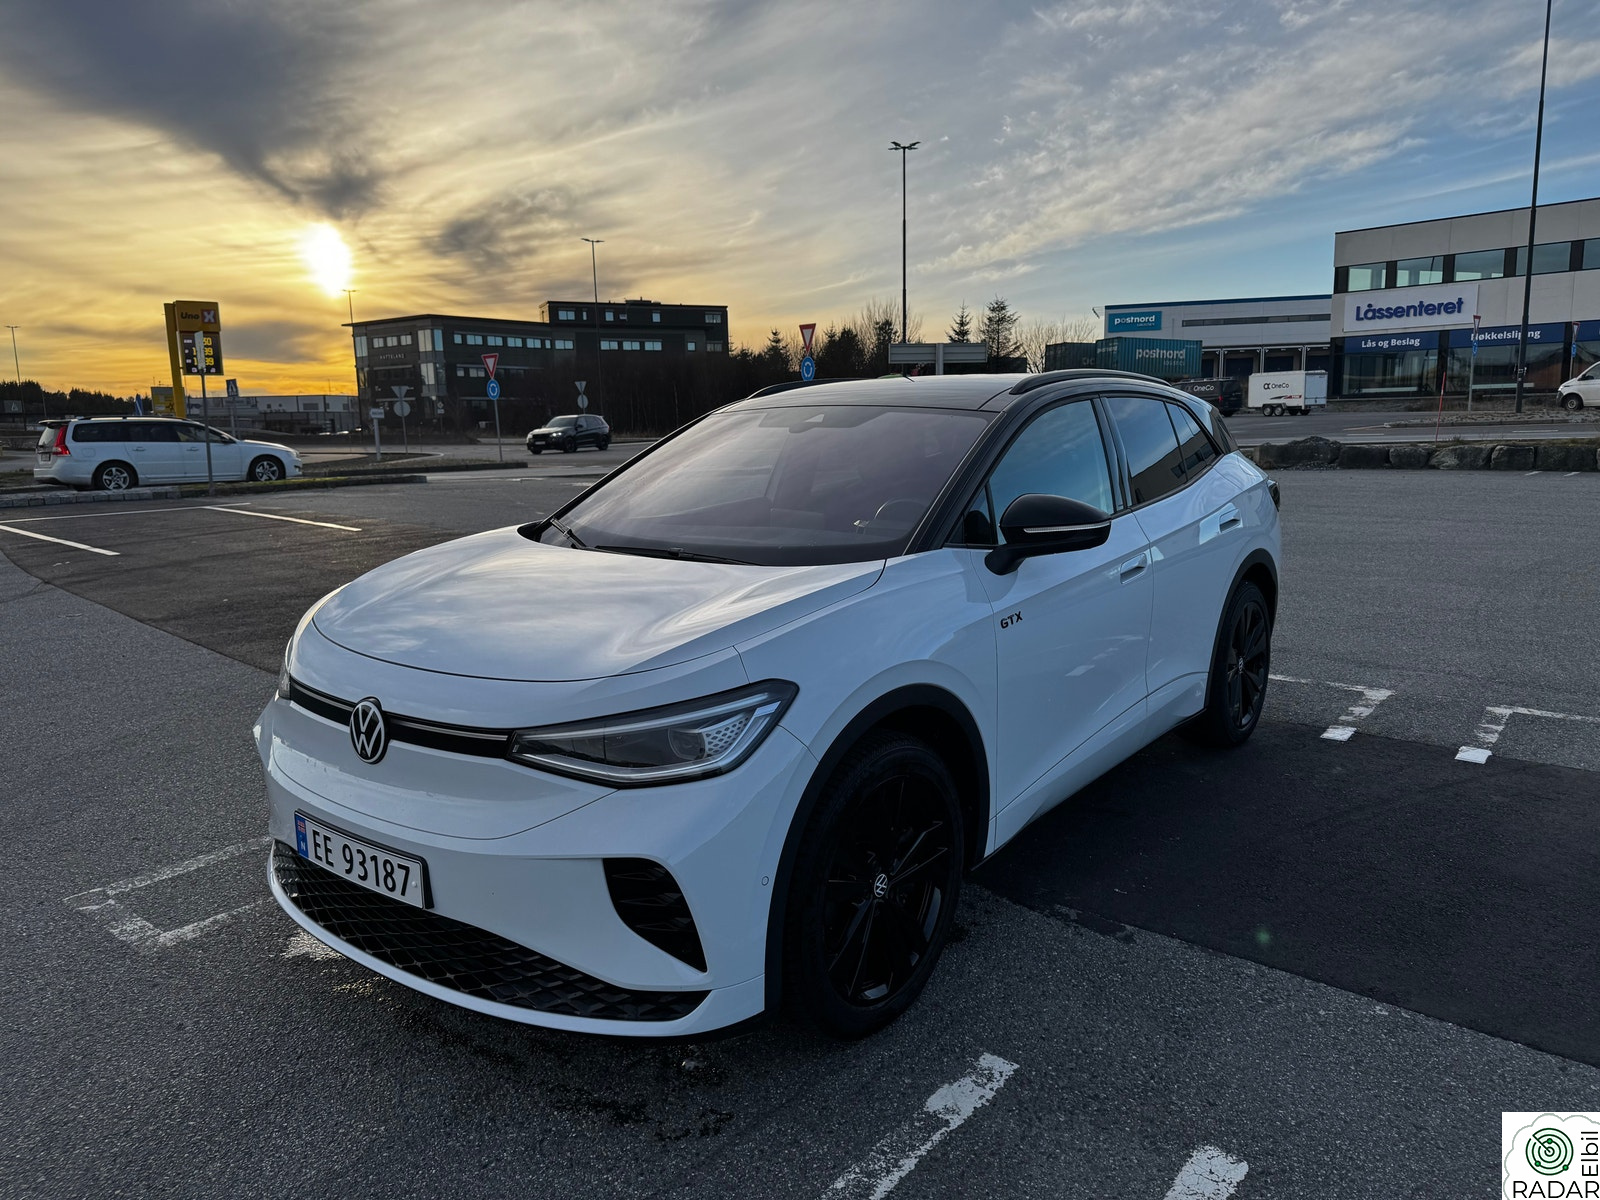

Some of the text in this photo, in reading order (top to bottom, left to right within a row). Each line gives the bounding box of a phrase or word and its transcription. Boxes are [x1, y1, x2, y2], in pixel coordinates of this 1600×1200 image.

[1356, 297, 1463, 321] Låssenteret
[180, 310, 215, 323] Uno X
[1114, 315, 1155, 325] postnord
[1471, 330, 1541, 341] Nøkkelsling
[1361, 339, 1376, 348] Lås
[1391, 338, 1420, 346] Beslag
[1136, 348, 1186, 359] postnord
[1193, 384, 1215, 392] OneCo
[1000, 611, 1023, 629] GTX
[312, 828, 410, 896] EE 93187
